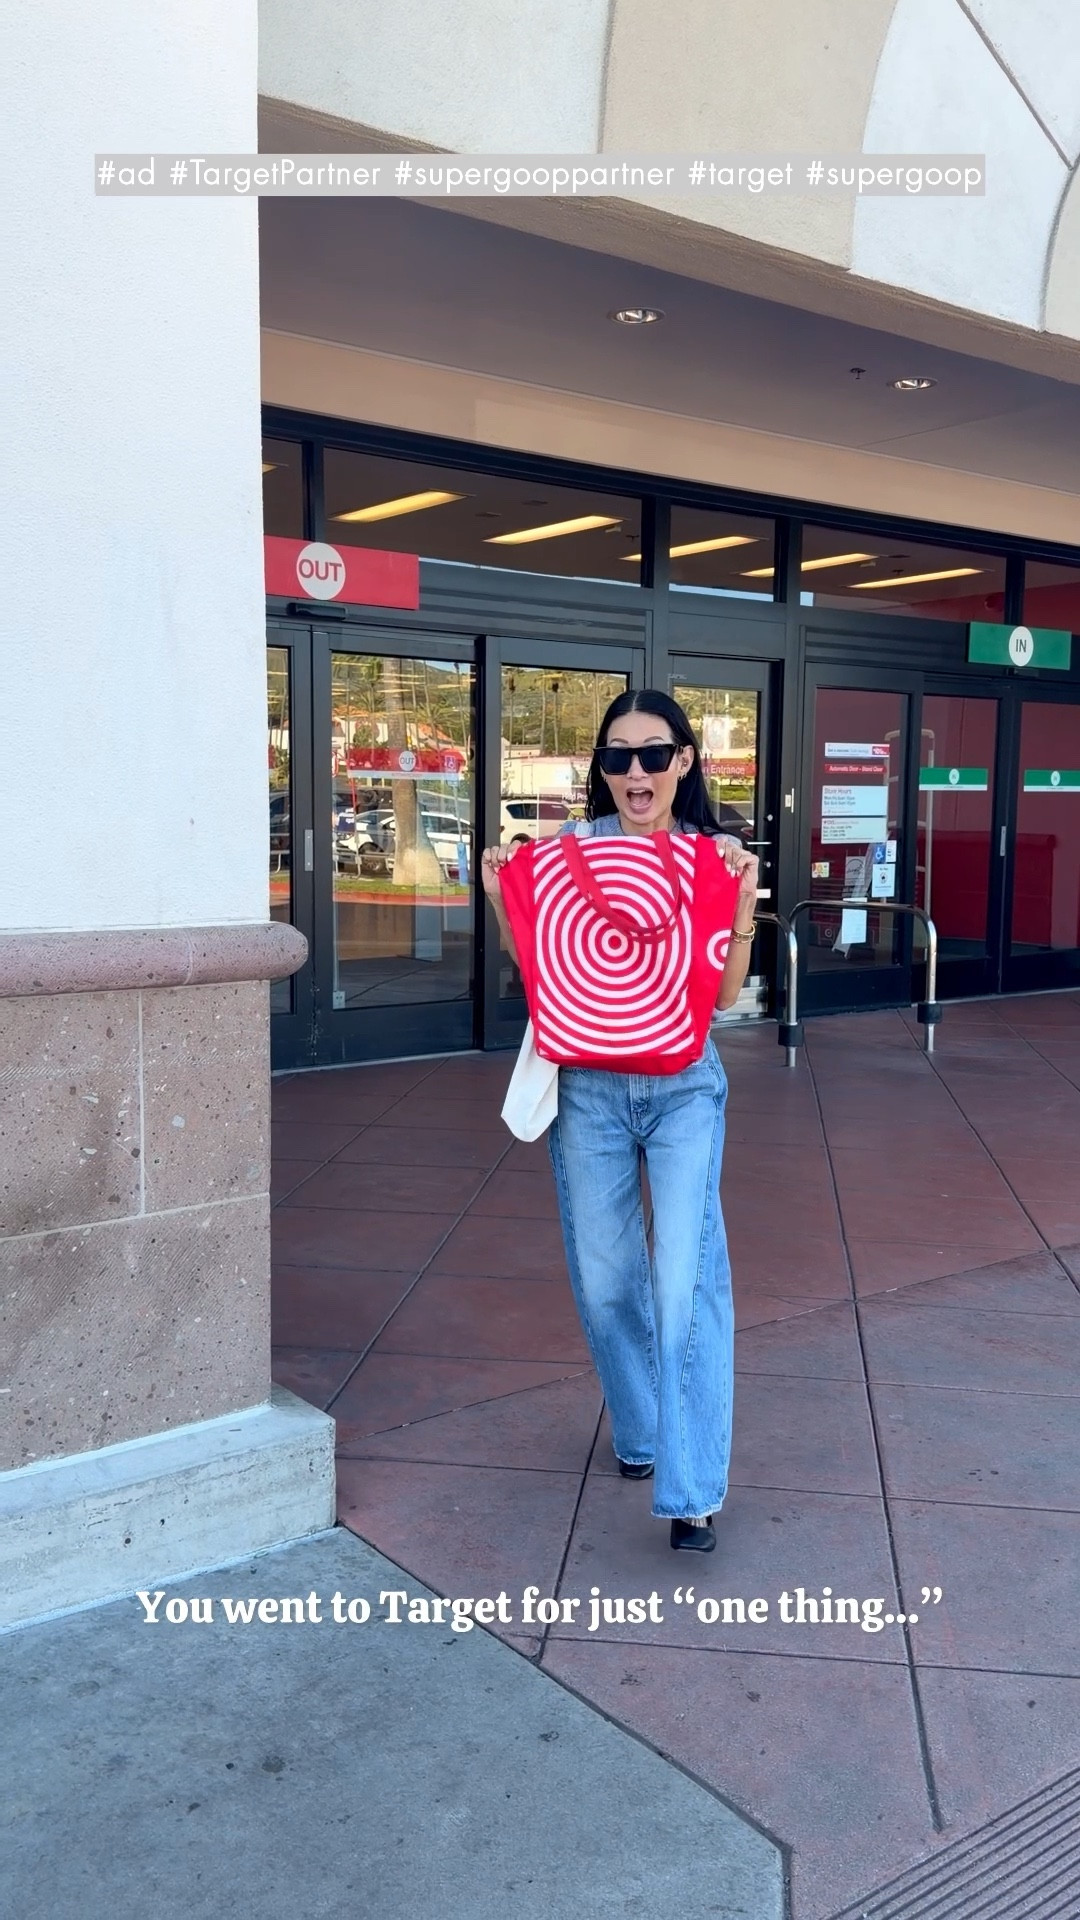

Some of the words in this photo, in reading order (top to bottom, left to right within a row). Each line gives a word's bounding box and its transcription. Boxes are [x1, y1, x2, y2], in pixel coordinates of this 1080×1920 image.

[298, 558, 343, 582] OUT
[1015, 638, 1027, 653] IN
[400, 757, 415, 765] OUT
[711, 763, 746, 775] Entrance
